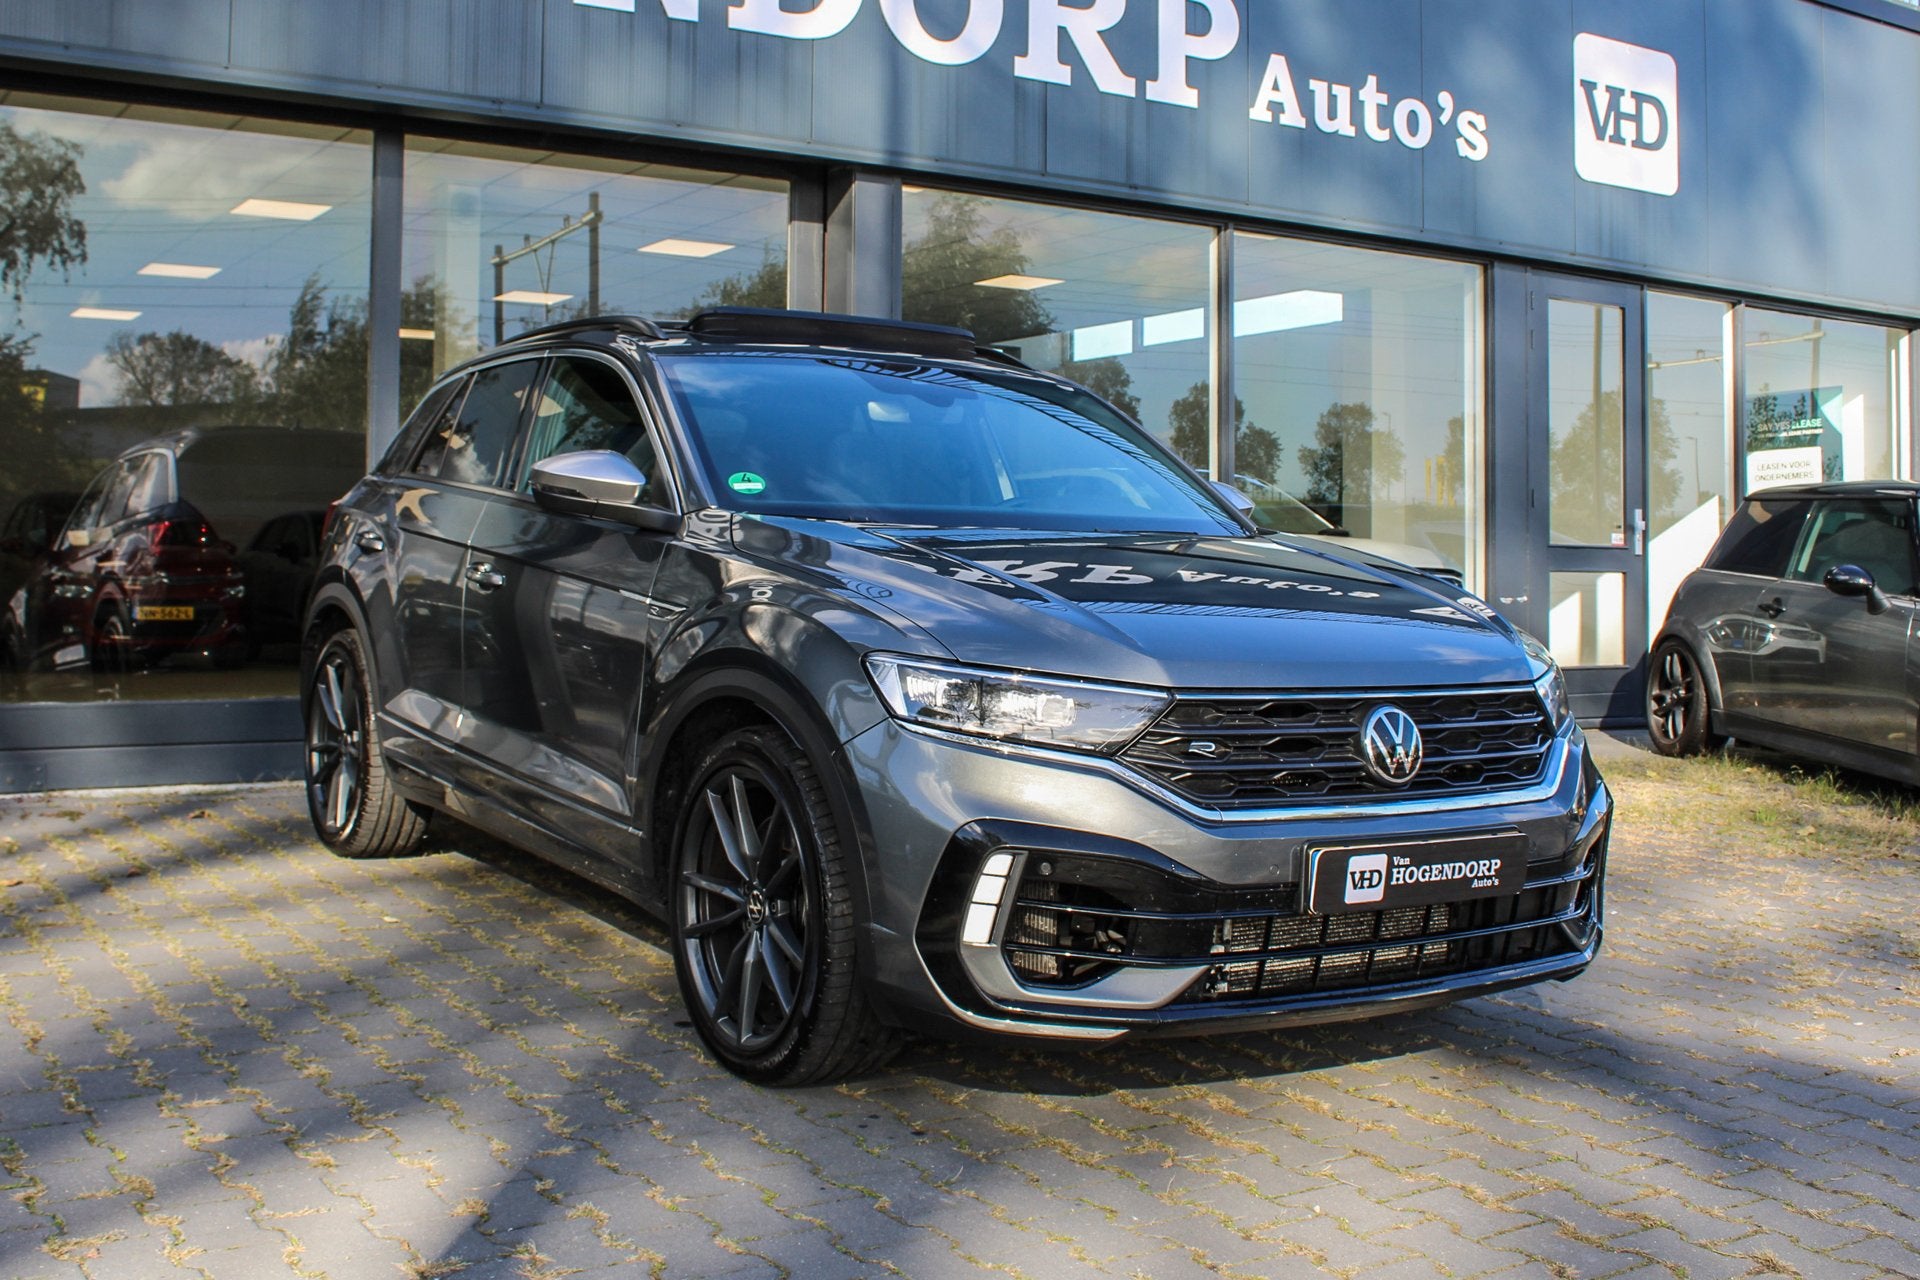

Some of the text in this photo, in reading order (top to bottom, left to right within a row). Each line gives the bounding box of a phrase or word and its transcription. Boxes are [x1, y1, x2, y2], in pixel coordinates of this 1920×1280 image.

[1580, 79, 1668, 152] VHD
[1393, 856, 1410, 866] Van
[1350, 859, 1502, 891] VHD HOGENDORP
[1471, 877, 1500, 889] Auto's
